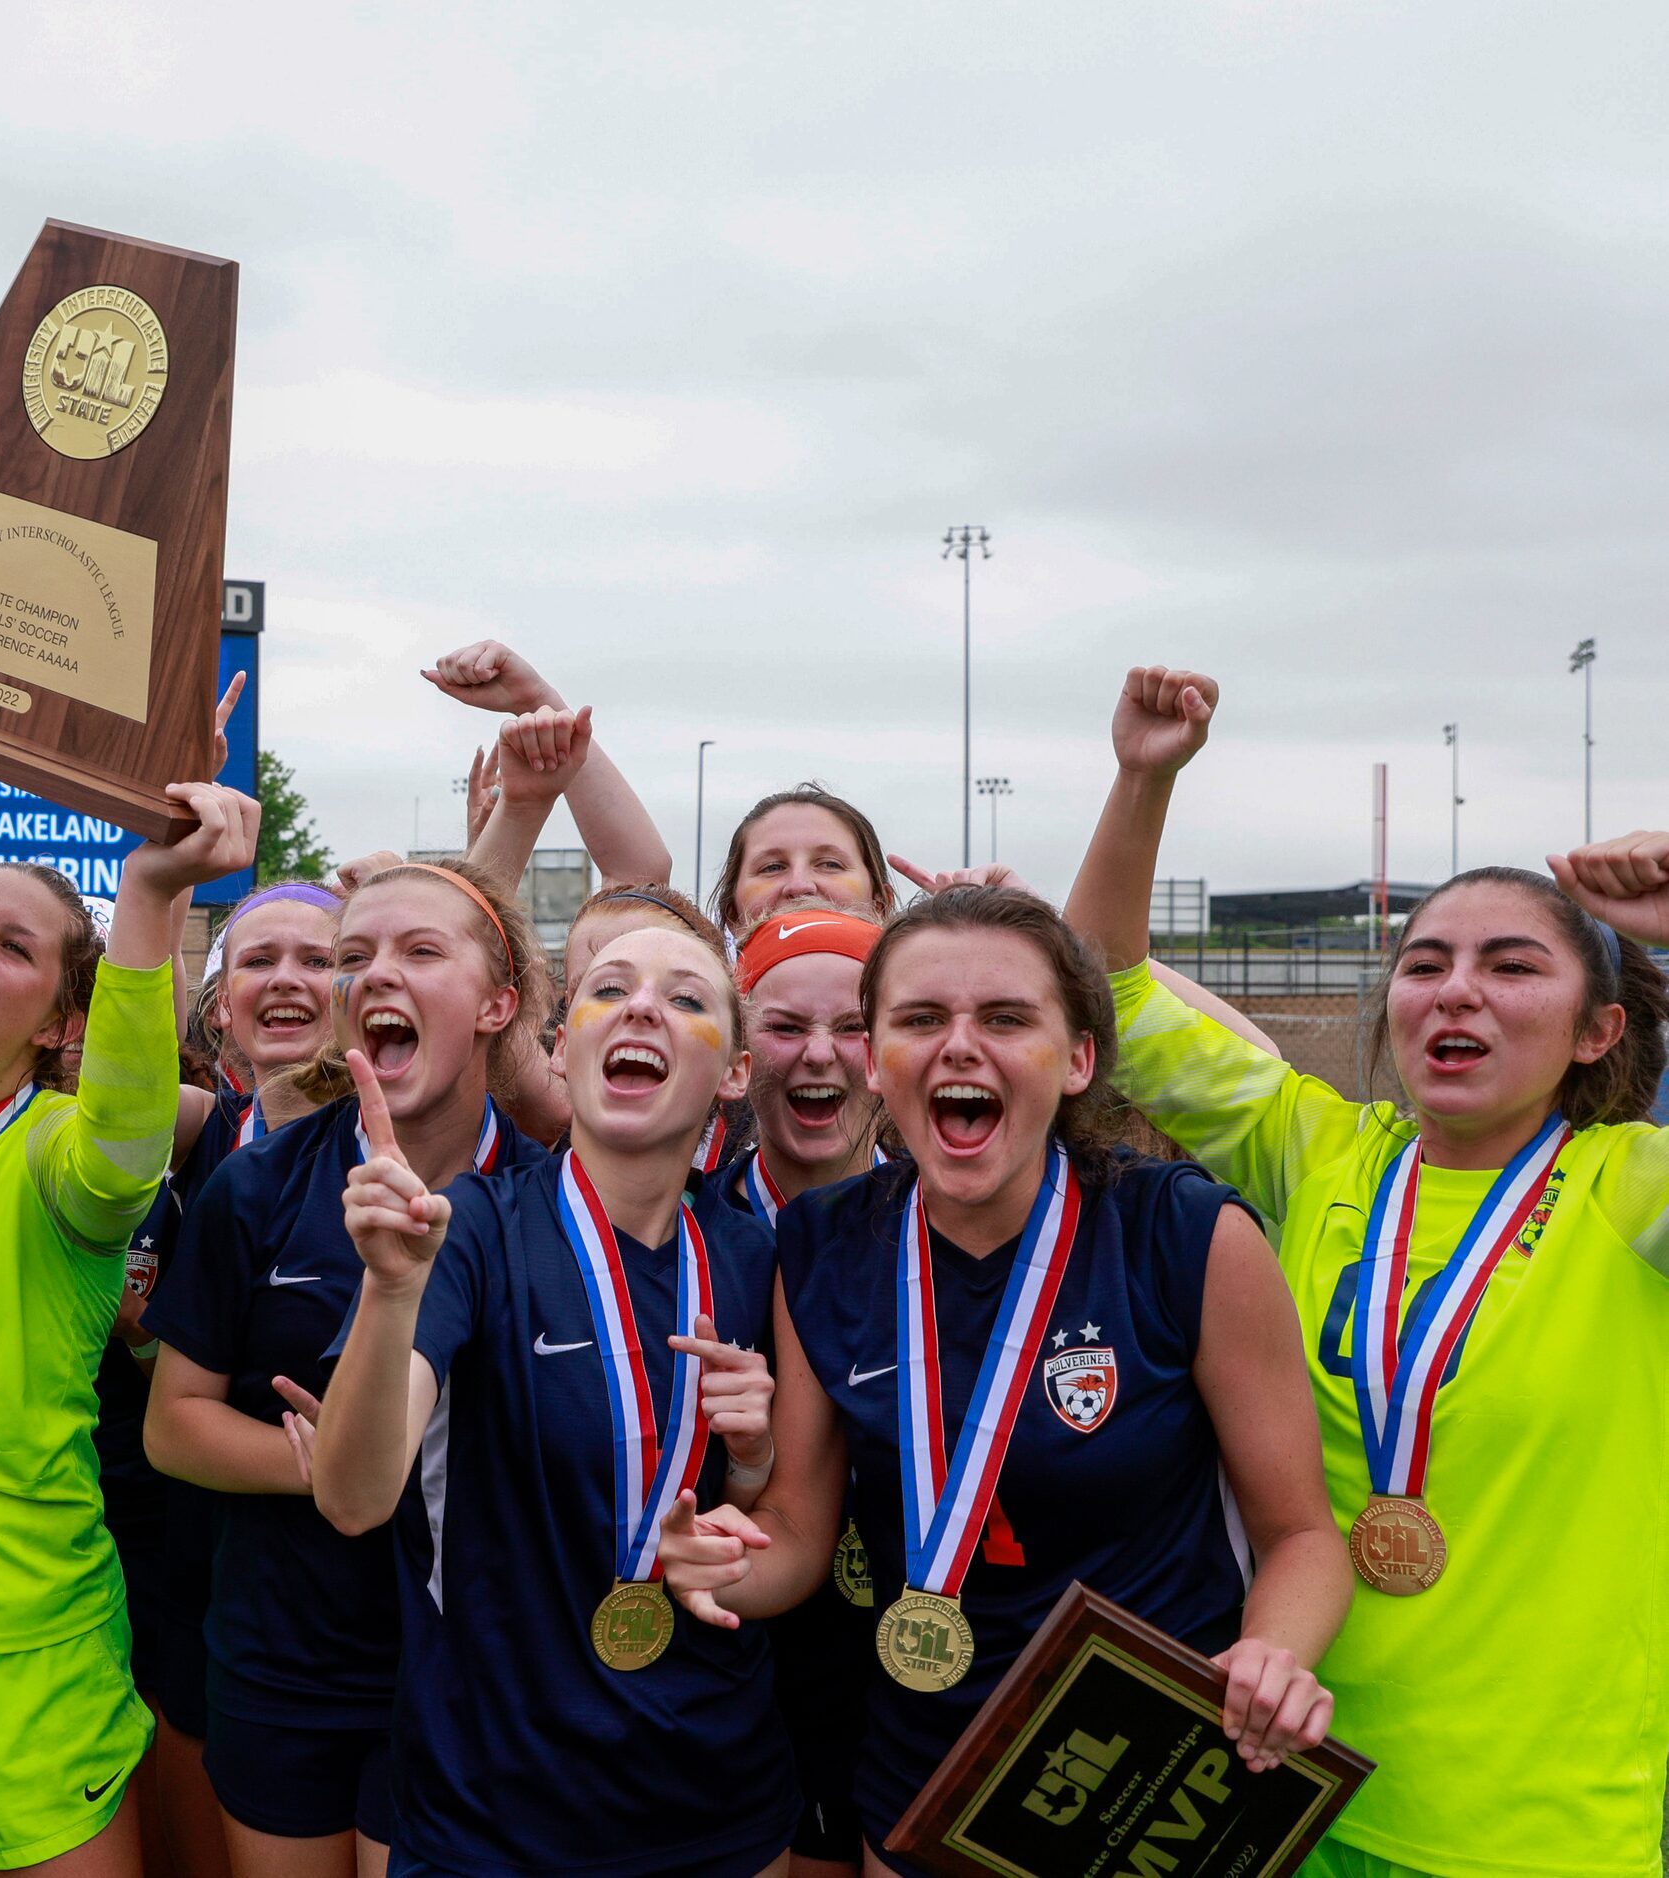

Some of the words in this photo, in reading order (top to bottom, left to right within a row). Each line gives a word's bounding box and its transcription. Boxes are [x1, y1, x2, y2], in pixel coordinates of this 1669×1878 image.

[61, 288, 168, 373] INTERSCHOLASTIC
[24, 320, 56, 434] UNIVERSITY
[55, 392, 113, 426] STATE
[109, 384, 163, 450] LEAGUE
[7, 526, 105, 585] INTERSCHOLASTIC
[99, 583, 125, 640] LEAGUE
[15, 598, 80, 631] CHAMPION
[18, 621, 68, 648] SOCCER
[37, 649, 79, 674] AAAAA
[1047, 1353, 1111, 1375] WOLVERINES
[1379, 1564, 1417, 1575] STATE
[877, 1617, 901, 1679] UNIVERSITY
[893, 1599, 973, 1643] INTERSCHOLASTIC
[944, 1651, 972, 1687] LEAGUE
[903, 1657, 942, 1674] STATE
[1099, 1770, 1144, 1825] Soccer
[1106, 1723, 1204, 1847] Championships
[1111, 1748, 1232, 1878] MVP
[1224, 1843, 1260, 1878] 2022
